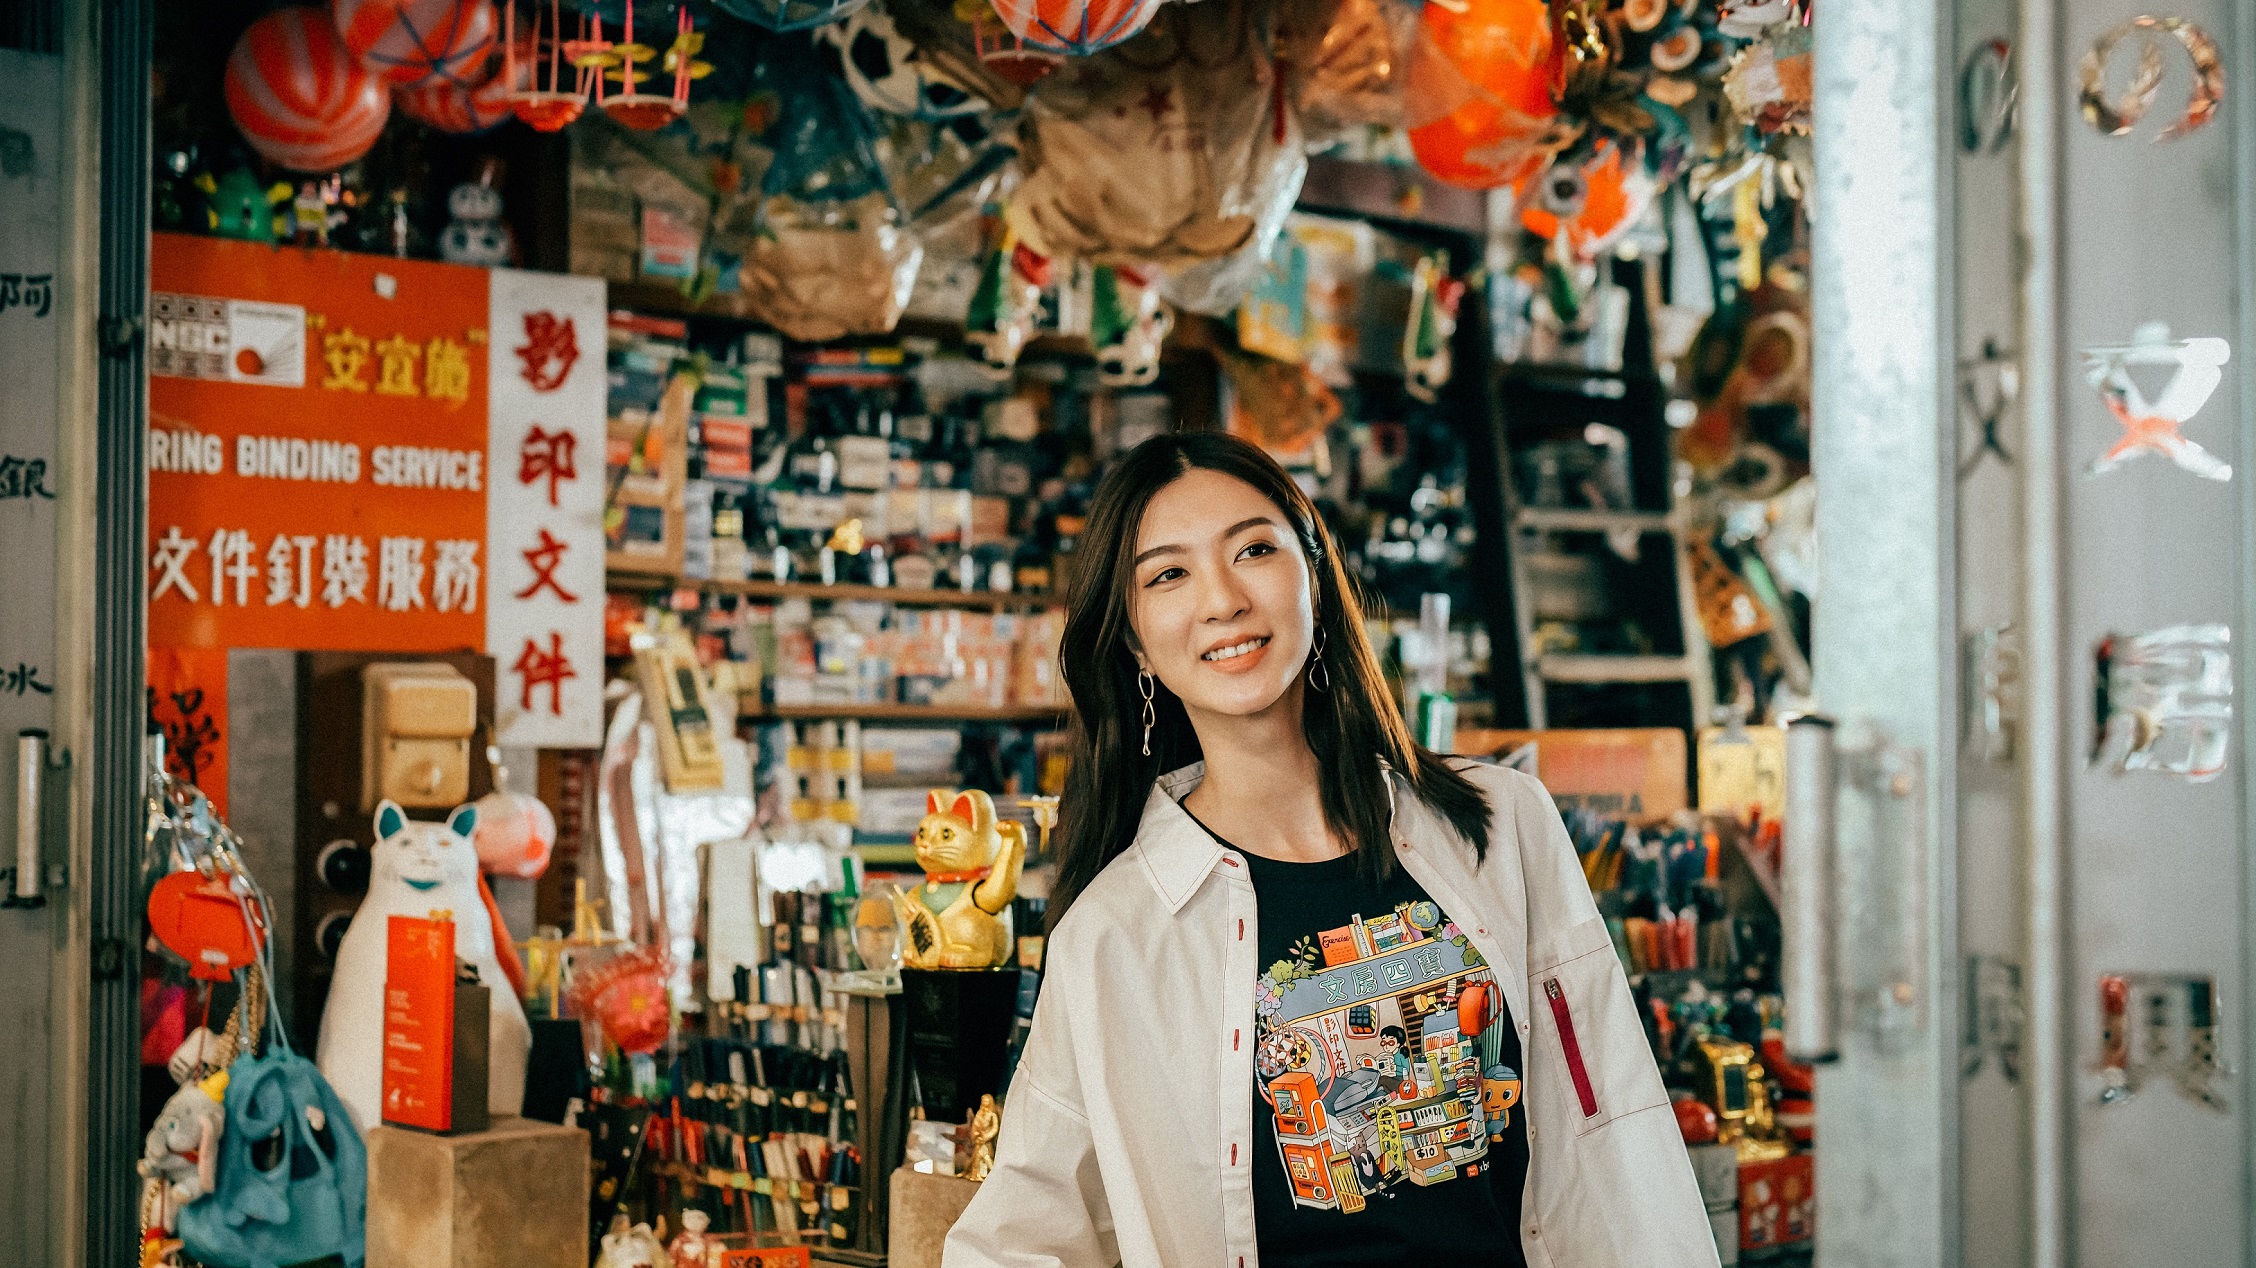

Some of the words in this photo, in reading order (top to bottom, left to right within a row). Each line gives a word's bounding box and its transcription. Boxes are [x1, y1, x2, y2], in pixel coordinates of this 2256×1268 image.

[150, 428, 223, 474] RING
[237, 435, 360, 482] BINDING
[371, 446, 482, 491] SERVICE
[514, 309, 581, 717] 影印文件
[151, 525, 480, 614] 文件釘裝服務
[1318, 947, 1445, 1004] 文房四寶
[1324, 1018, 1347, 1076] 影印文件
[1416, 1147, 1435, 1159] $10
